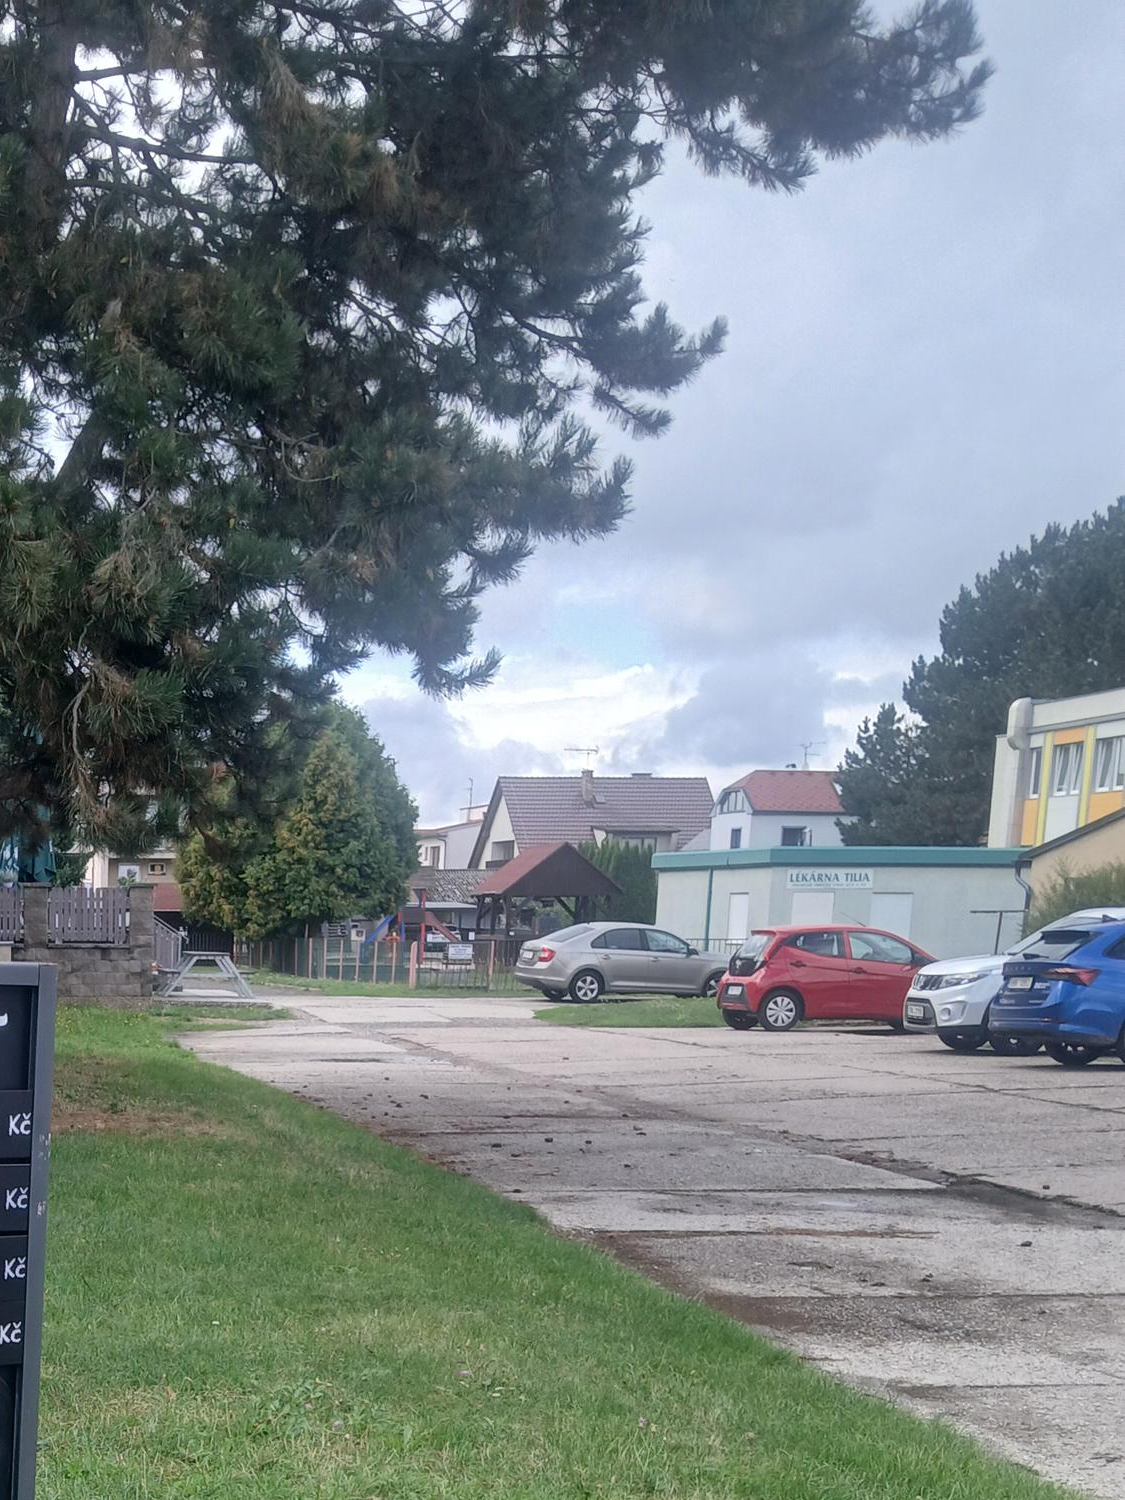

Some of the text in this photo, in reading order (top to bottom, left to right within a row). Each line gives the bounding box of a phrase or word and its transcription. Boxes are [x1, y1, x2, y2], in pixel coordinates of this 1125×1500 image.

[789, 870, 871, 883] LÉKÁRNA TILIA
[8, 1112, 32, 1137] Kč
[5, 1186, 29, 1211] Kč
[3, 1256, 26, 1280] Kč
